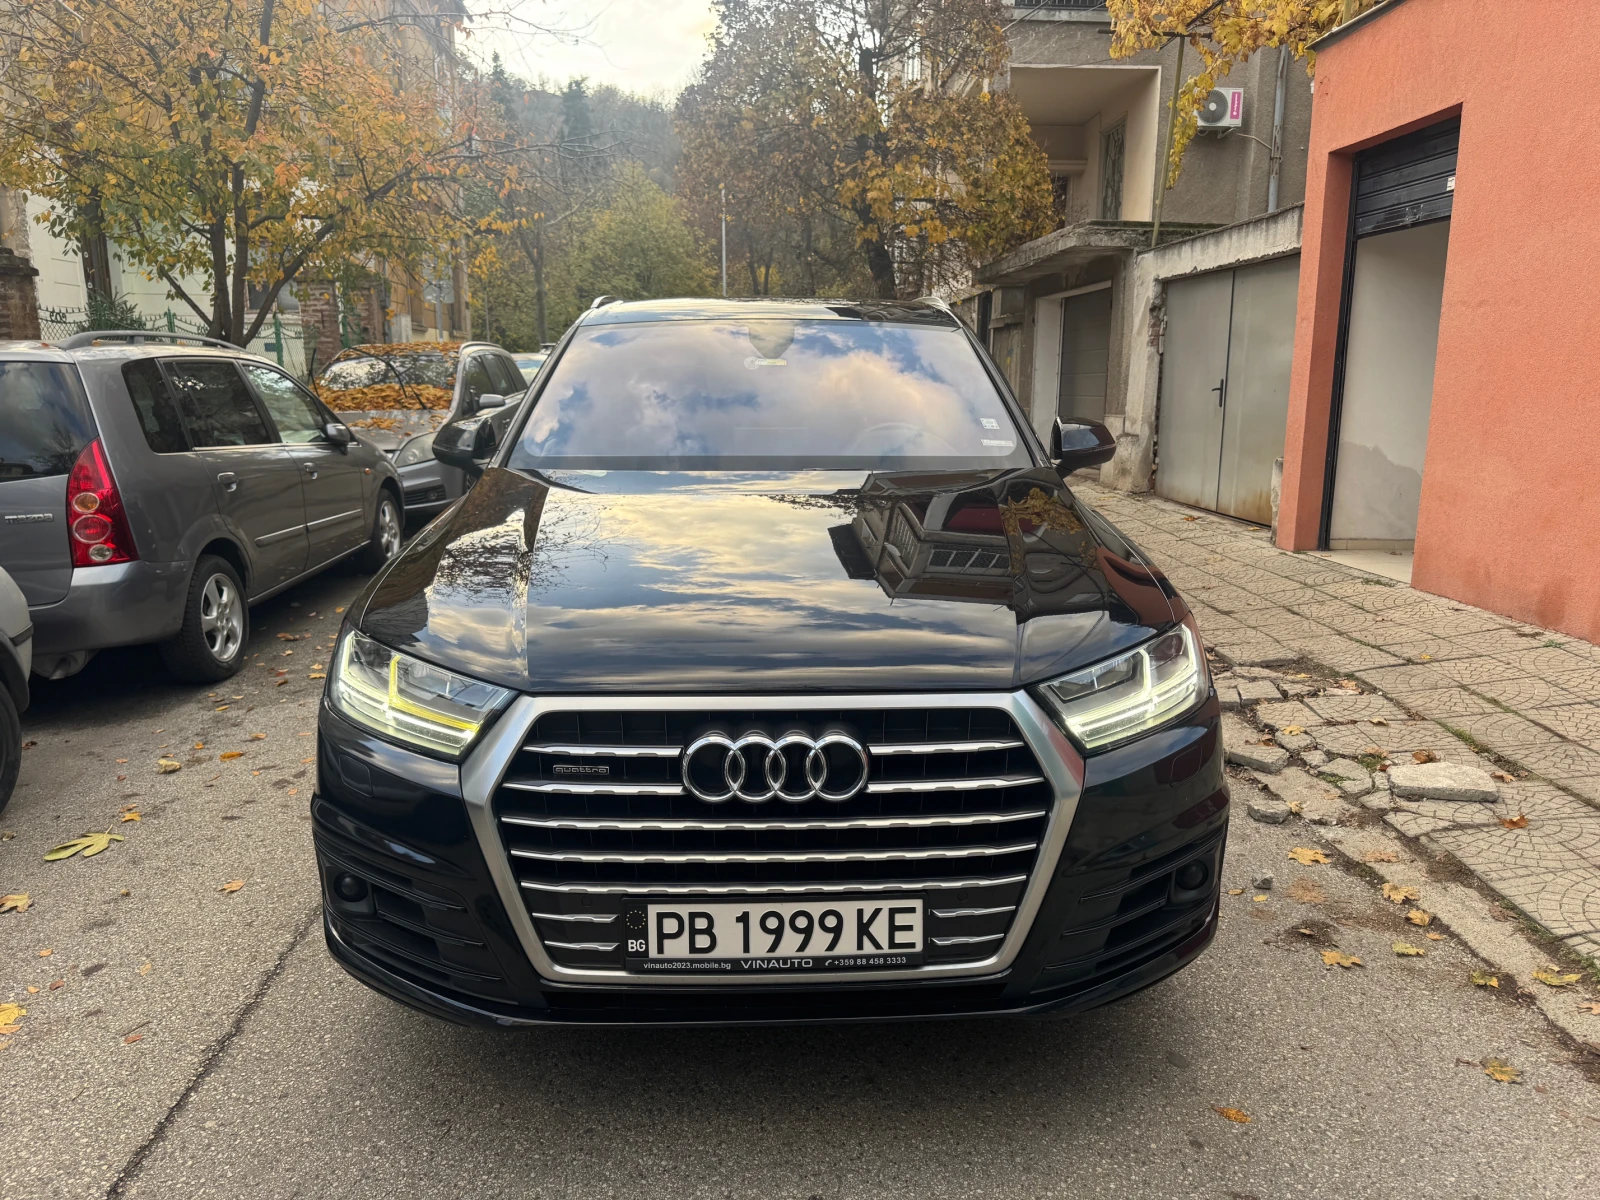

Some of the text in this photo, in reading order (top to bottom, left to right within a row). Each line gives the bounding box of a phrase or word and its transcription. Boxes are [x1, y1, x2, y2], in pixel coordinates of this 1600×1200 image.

[656, 906, 917, 955] PB 1999 KE
[627, 939, 646, 952] BG
[643, 962, 732, 970] vinauto2023.mobile.bg
[740, 958, 813, 969] VINAUTO
[868, 957, 884, 965] 458
[886, 956, 907, 964] 3333
